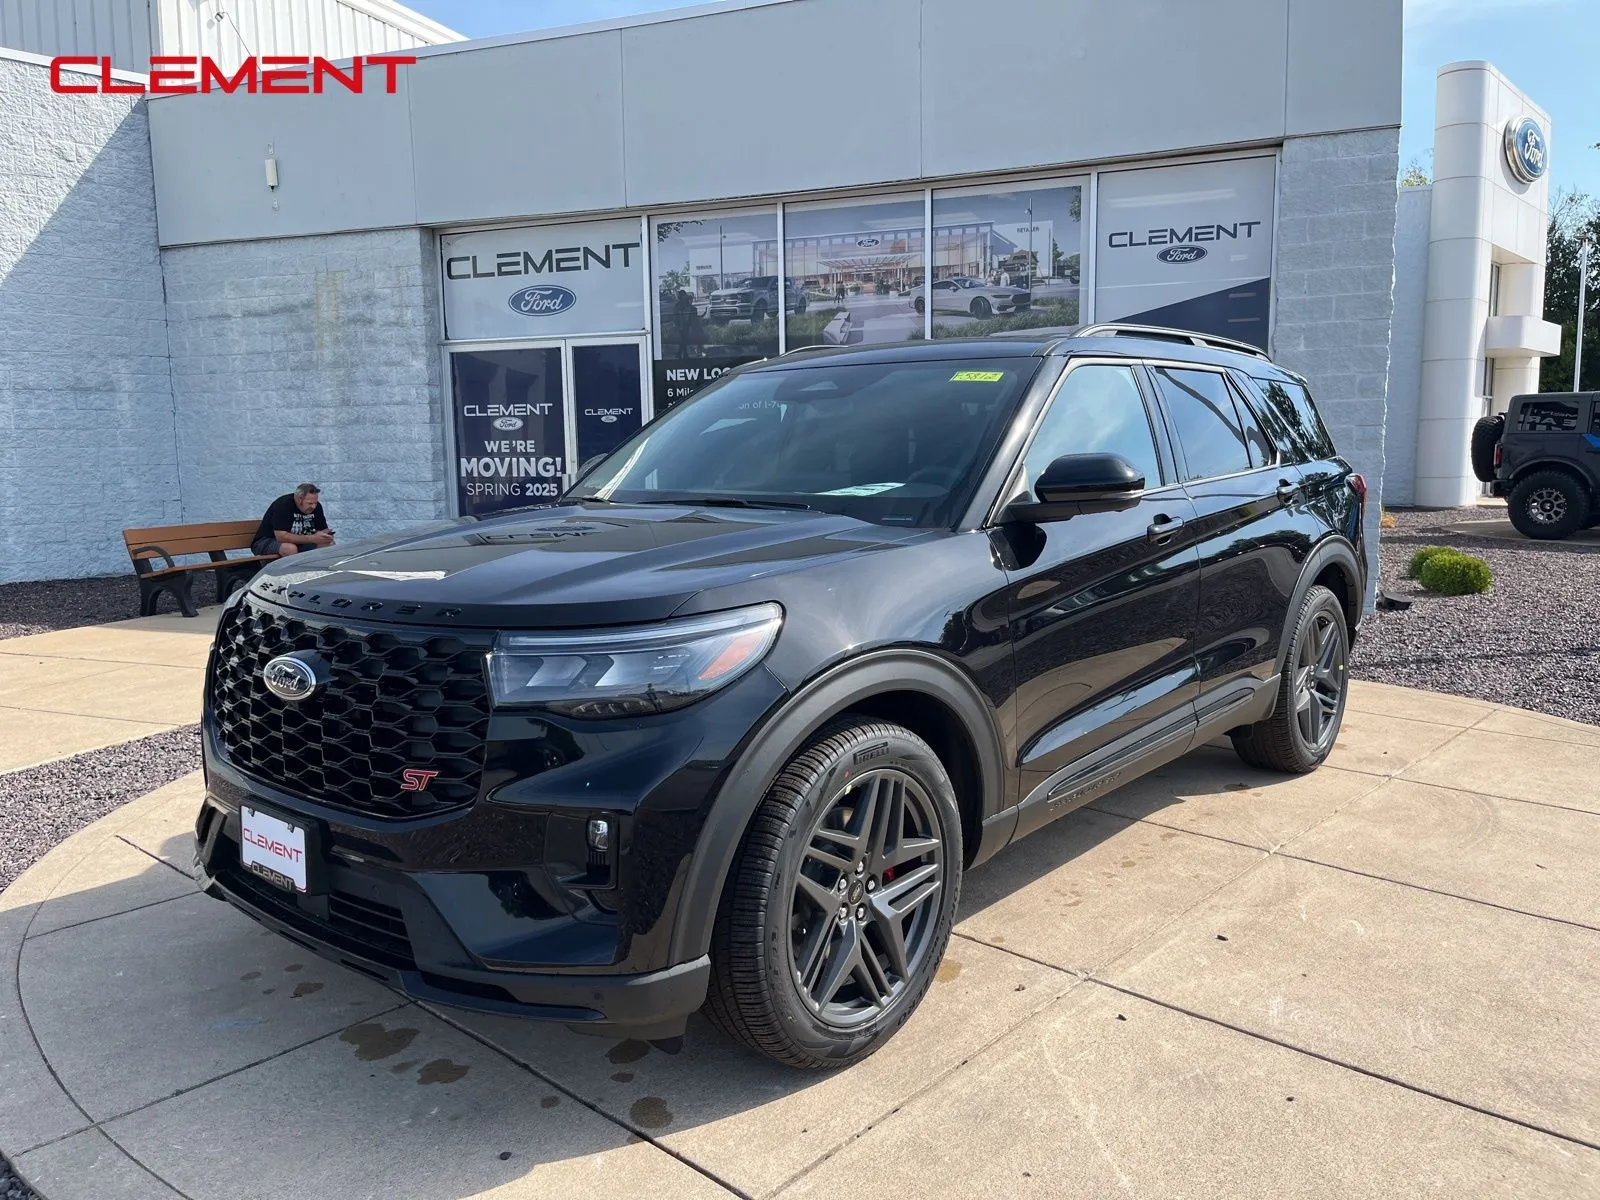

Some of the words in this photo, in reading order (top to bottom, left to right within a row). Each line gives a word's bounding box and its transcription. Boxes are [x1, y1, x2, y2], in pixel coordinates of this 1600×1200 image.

[1108, 220, 1262, 249] CLEMENT
[446, 242, 640, 280] CLEMENT
[1166, 247, 1199, 262] Ford
[520, 289, 564, 312] Ford
[666, 368, 700, 381] NEW
[667, 388, 674, 397] 6
[464, 403, 553, 417] CLEMENT
[585, 408, 634, 416] CLEMENT
[484, 440, 536, 453] WE'RE
[460, 457, 562, 478] MOVING!
[467, 482, 521, 496] SPRING
[525, 483, 558, 496] 2025
[270, 663, 299, 692] Ford
[400, 768, 439, 791] ST
[243, 827, 303, 862] CLEMENT
[251, 862, 294, 892] CLEMENT
